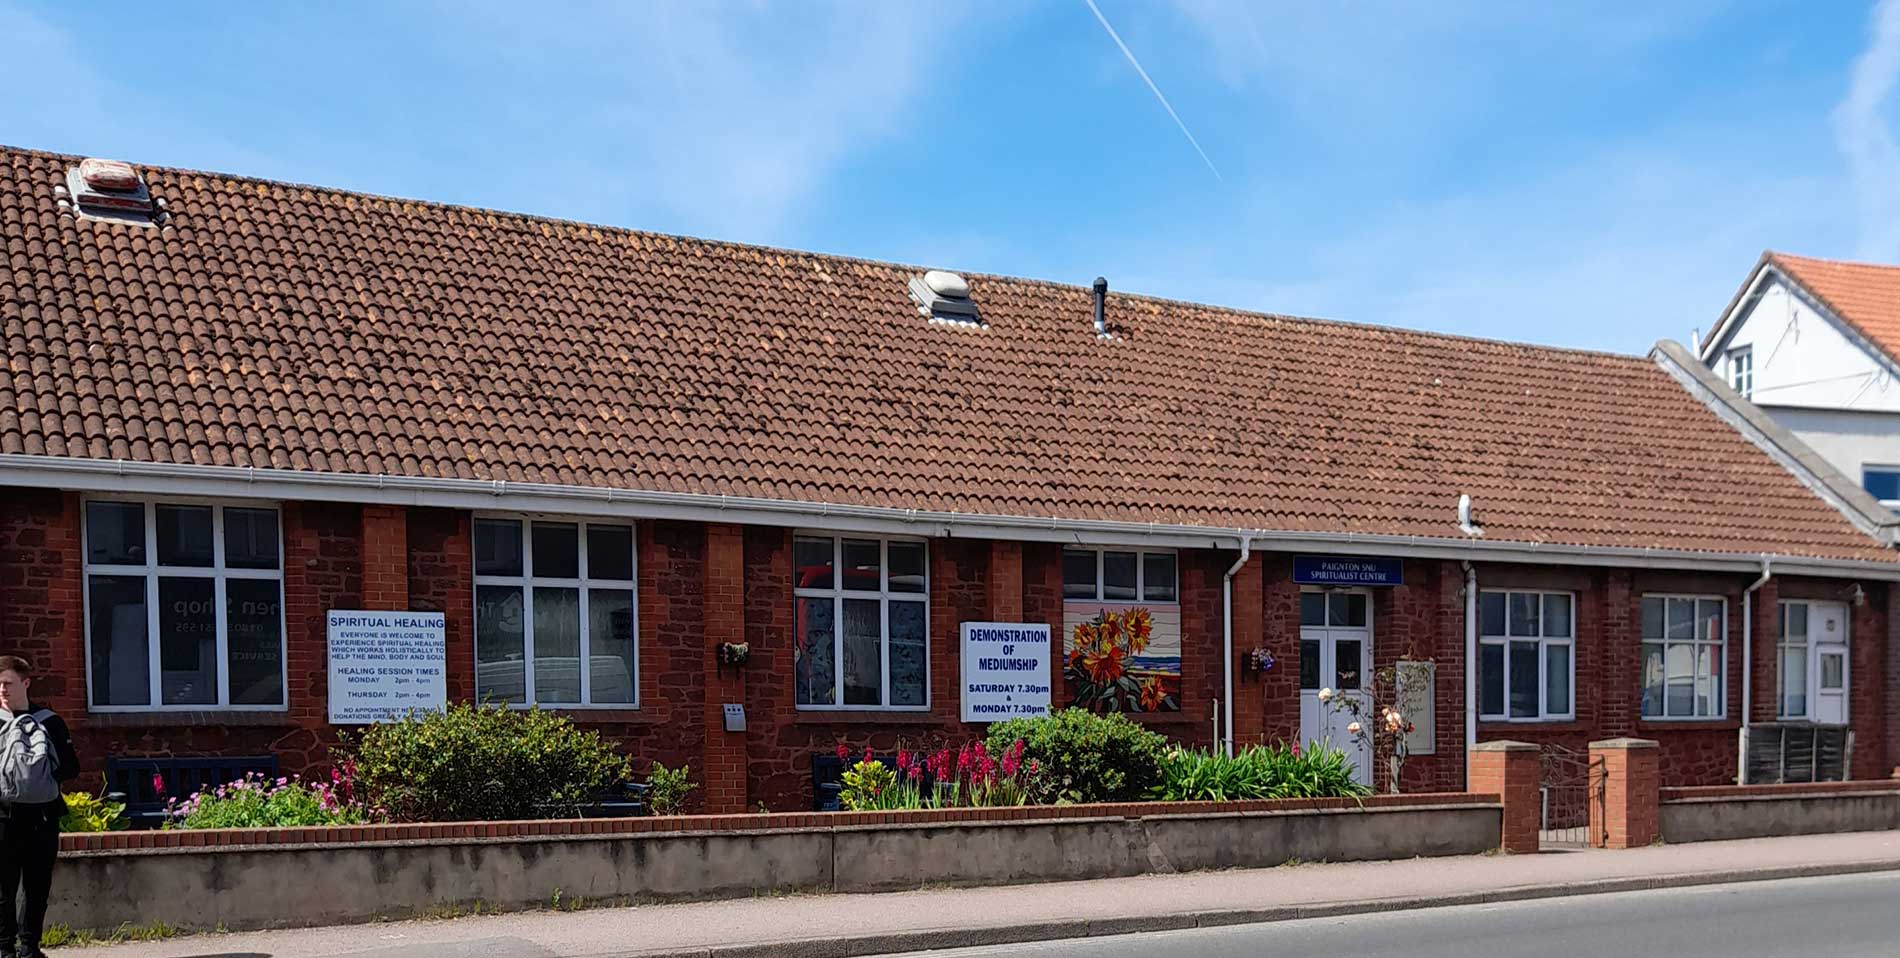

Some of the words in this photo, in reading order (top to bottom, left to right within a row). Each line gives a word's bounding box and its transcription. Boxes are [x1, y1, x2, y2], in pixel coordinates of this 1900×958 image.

[1322, 562, 1359, 571] PAIGNTON
[1362, 563, 1377, 571] SNU
[1311, 571, 1357, 580] SPIRITUALIST
[1360, 572, 1387, 581] CENTRE
[330, 617, 391, 627] SPIRITUAL
[394, 618, 444, 628] HEALING
[970, 629, 1047, 642] DEMONSTRATION
[1003, 645, 1015, 655] OF
[979, 658, 1038, 671] MEDIUMSHIP
[969, 684, 1015, 693] SATURDAY
[1017, 685, 1049, 694] 7.30pm
[973, 705, 1011, 713] MONDAY
[1014, 705, 1045, 714] 7.30pm
